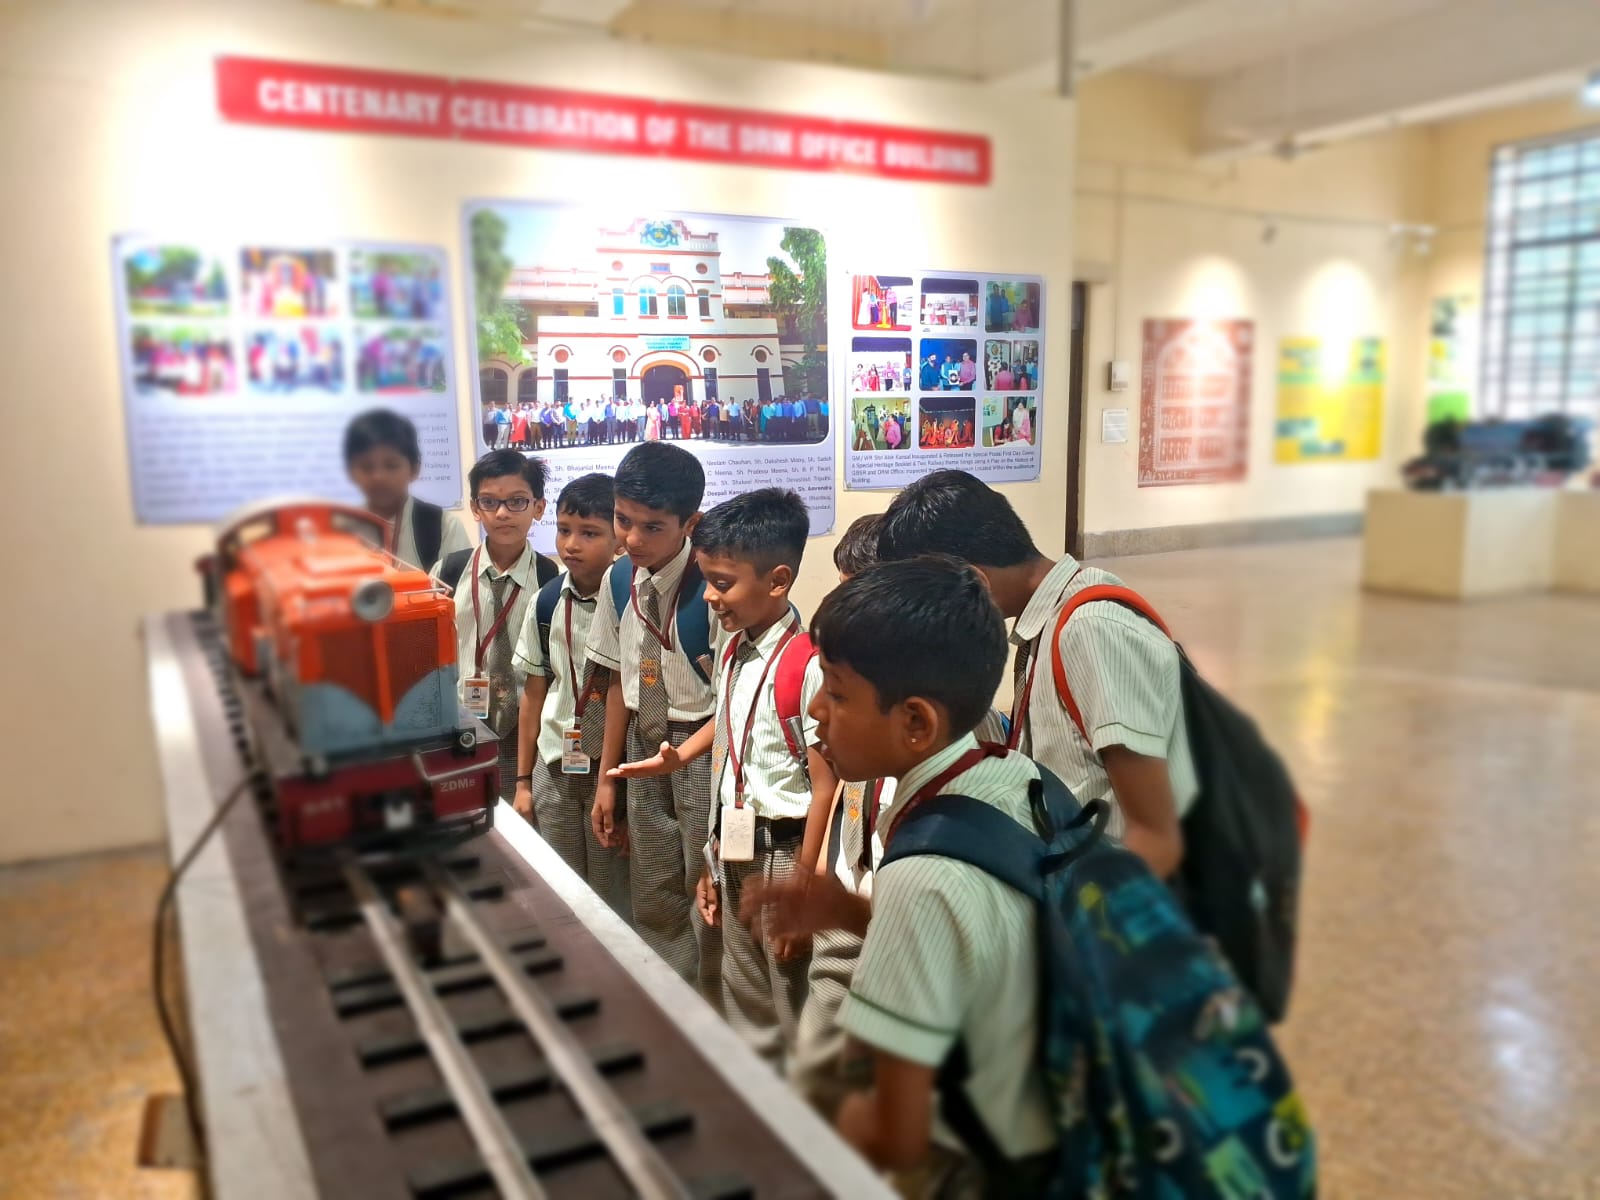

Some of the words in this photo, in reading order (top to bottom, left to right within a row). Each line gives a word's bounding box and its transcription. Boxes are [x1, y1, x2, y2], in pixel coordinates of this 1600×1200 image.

[258, 79, 441, 123] CENTENARY
[451, 97, 636, 141] CELEBRATION
[645, 116, 677, 145] OF
[686, 119, 730, 150] THE
[740, 125, 791, 156] DRM
[800, 132, 876, 164] OFFICE
[884, 140, 978, 173] BUILDING
